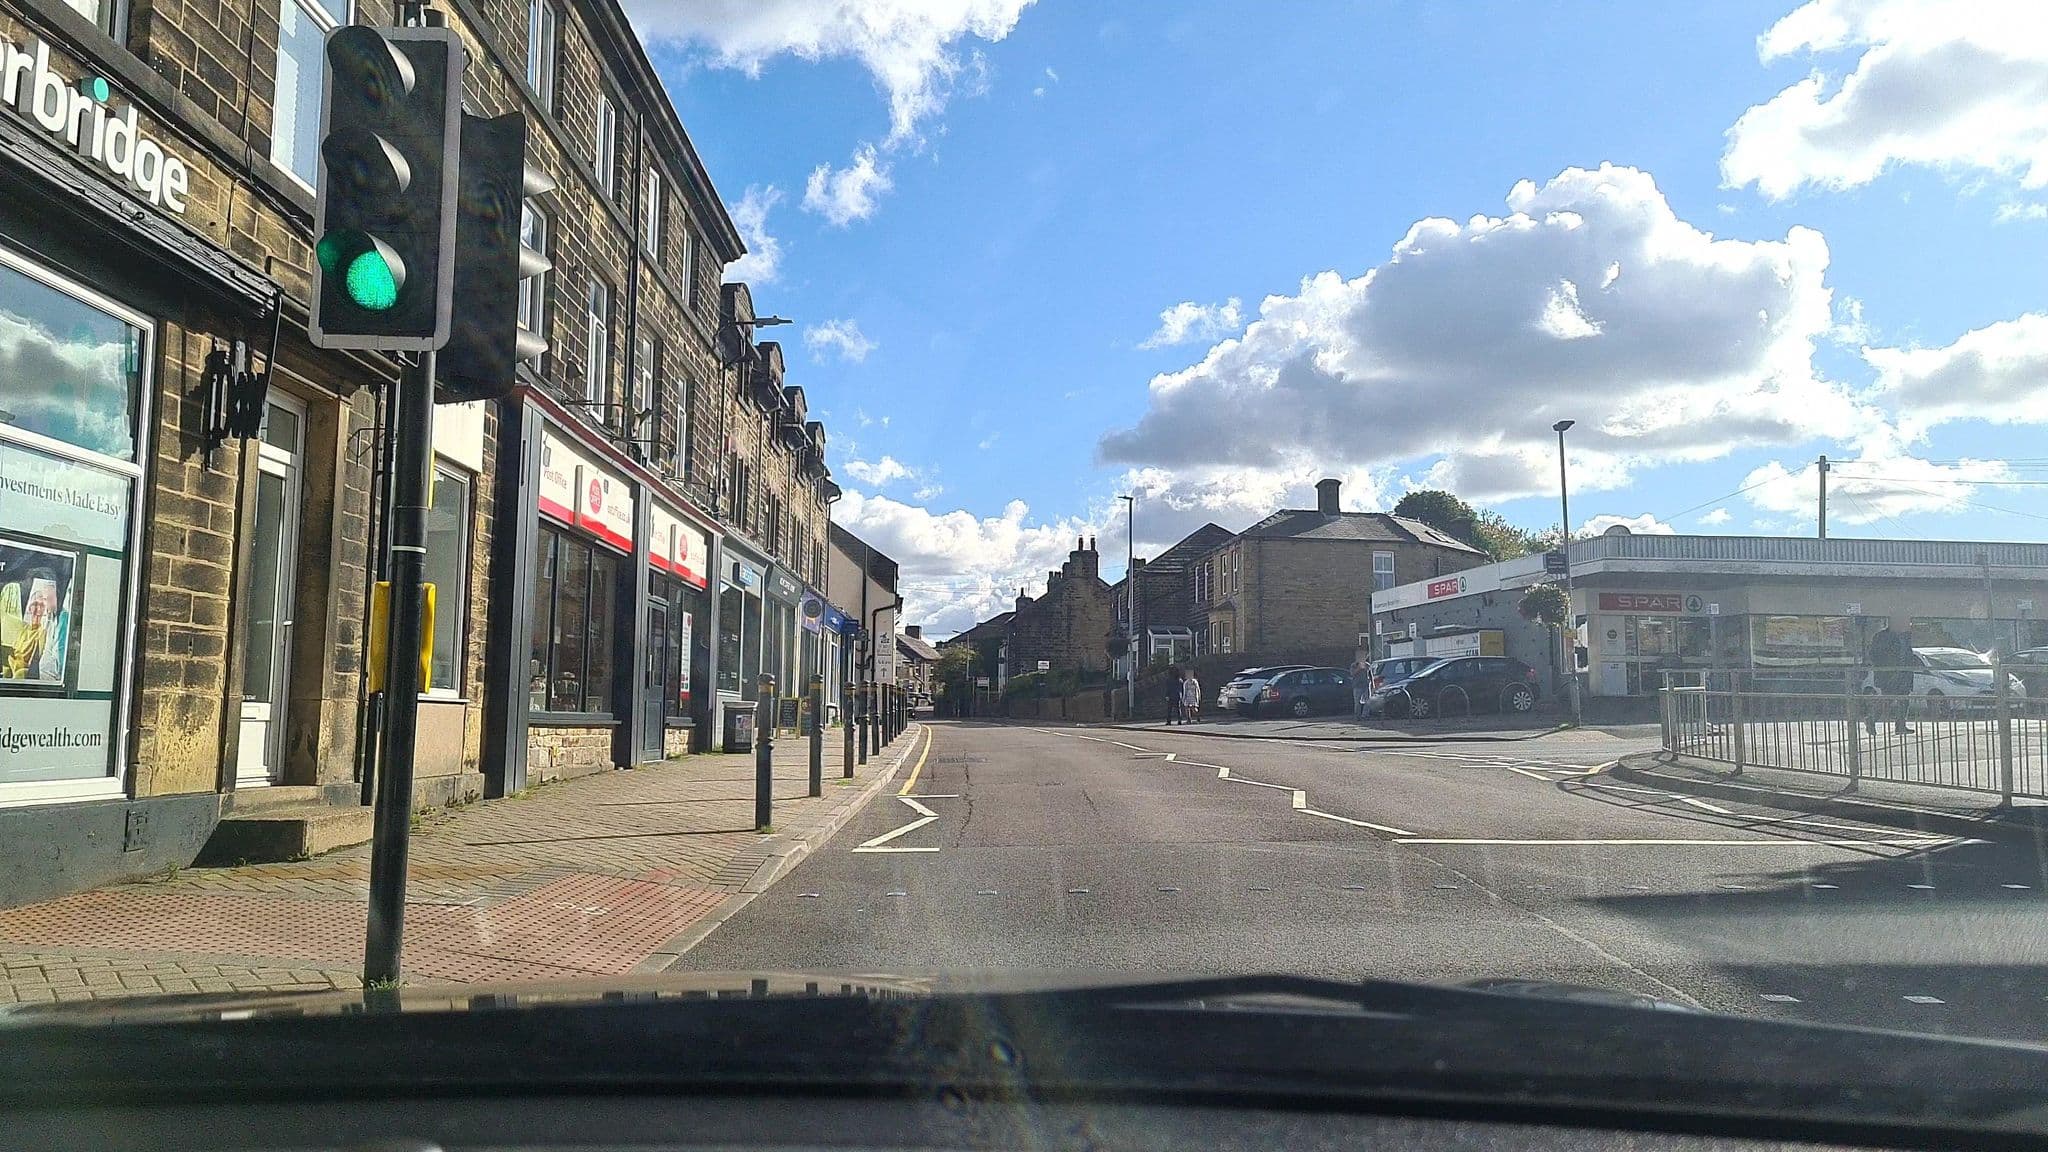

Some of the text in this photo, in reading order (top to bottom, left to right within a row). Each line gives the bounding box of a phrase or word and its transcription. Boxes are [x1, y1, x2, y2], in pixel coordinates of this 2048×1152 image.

[0, 38, 188, 213] rbridge
[64, 487, 96, 511] Made
[96, 496, 121, 520] Easy
[1434, 581, 1459, 595] SPAR
[1617, 595, 1681, 609] SPAR
